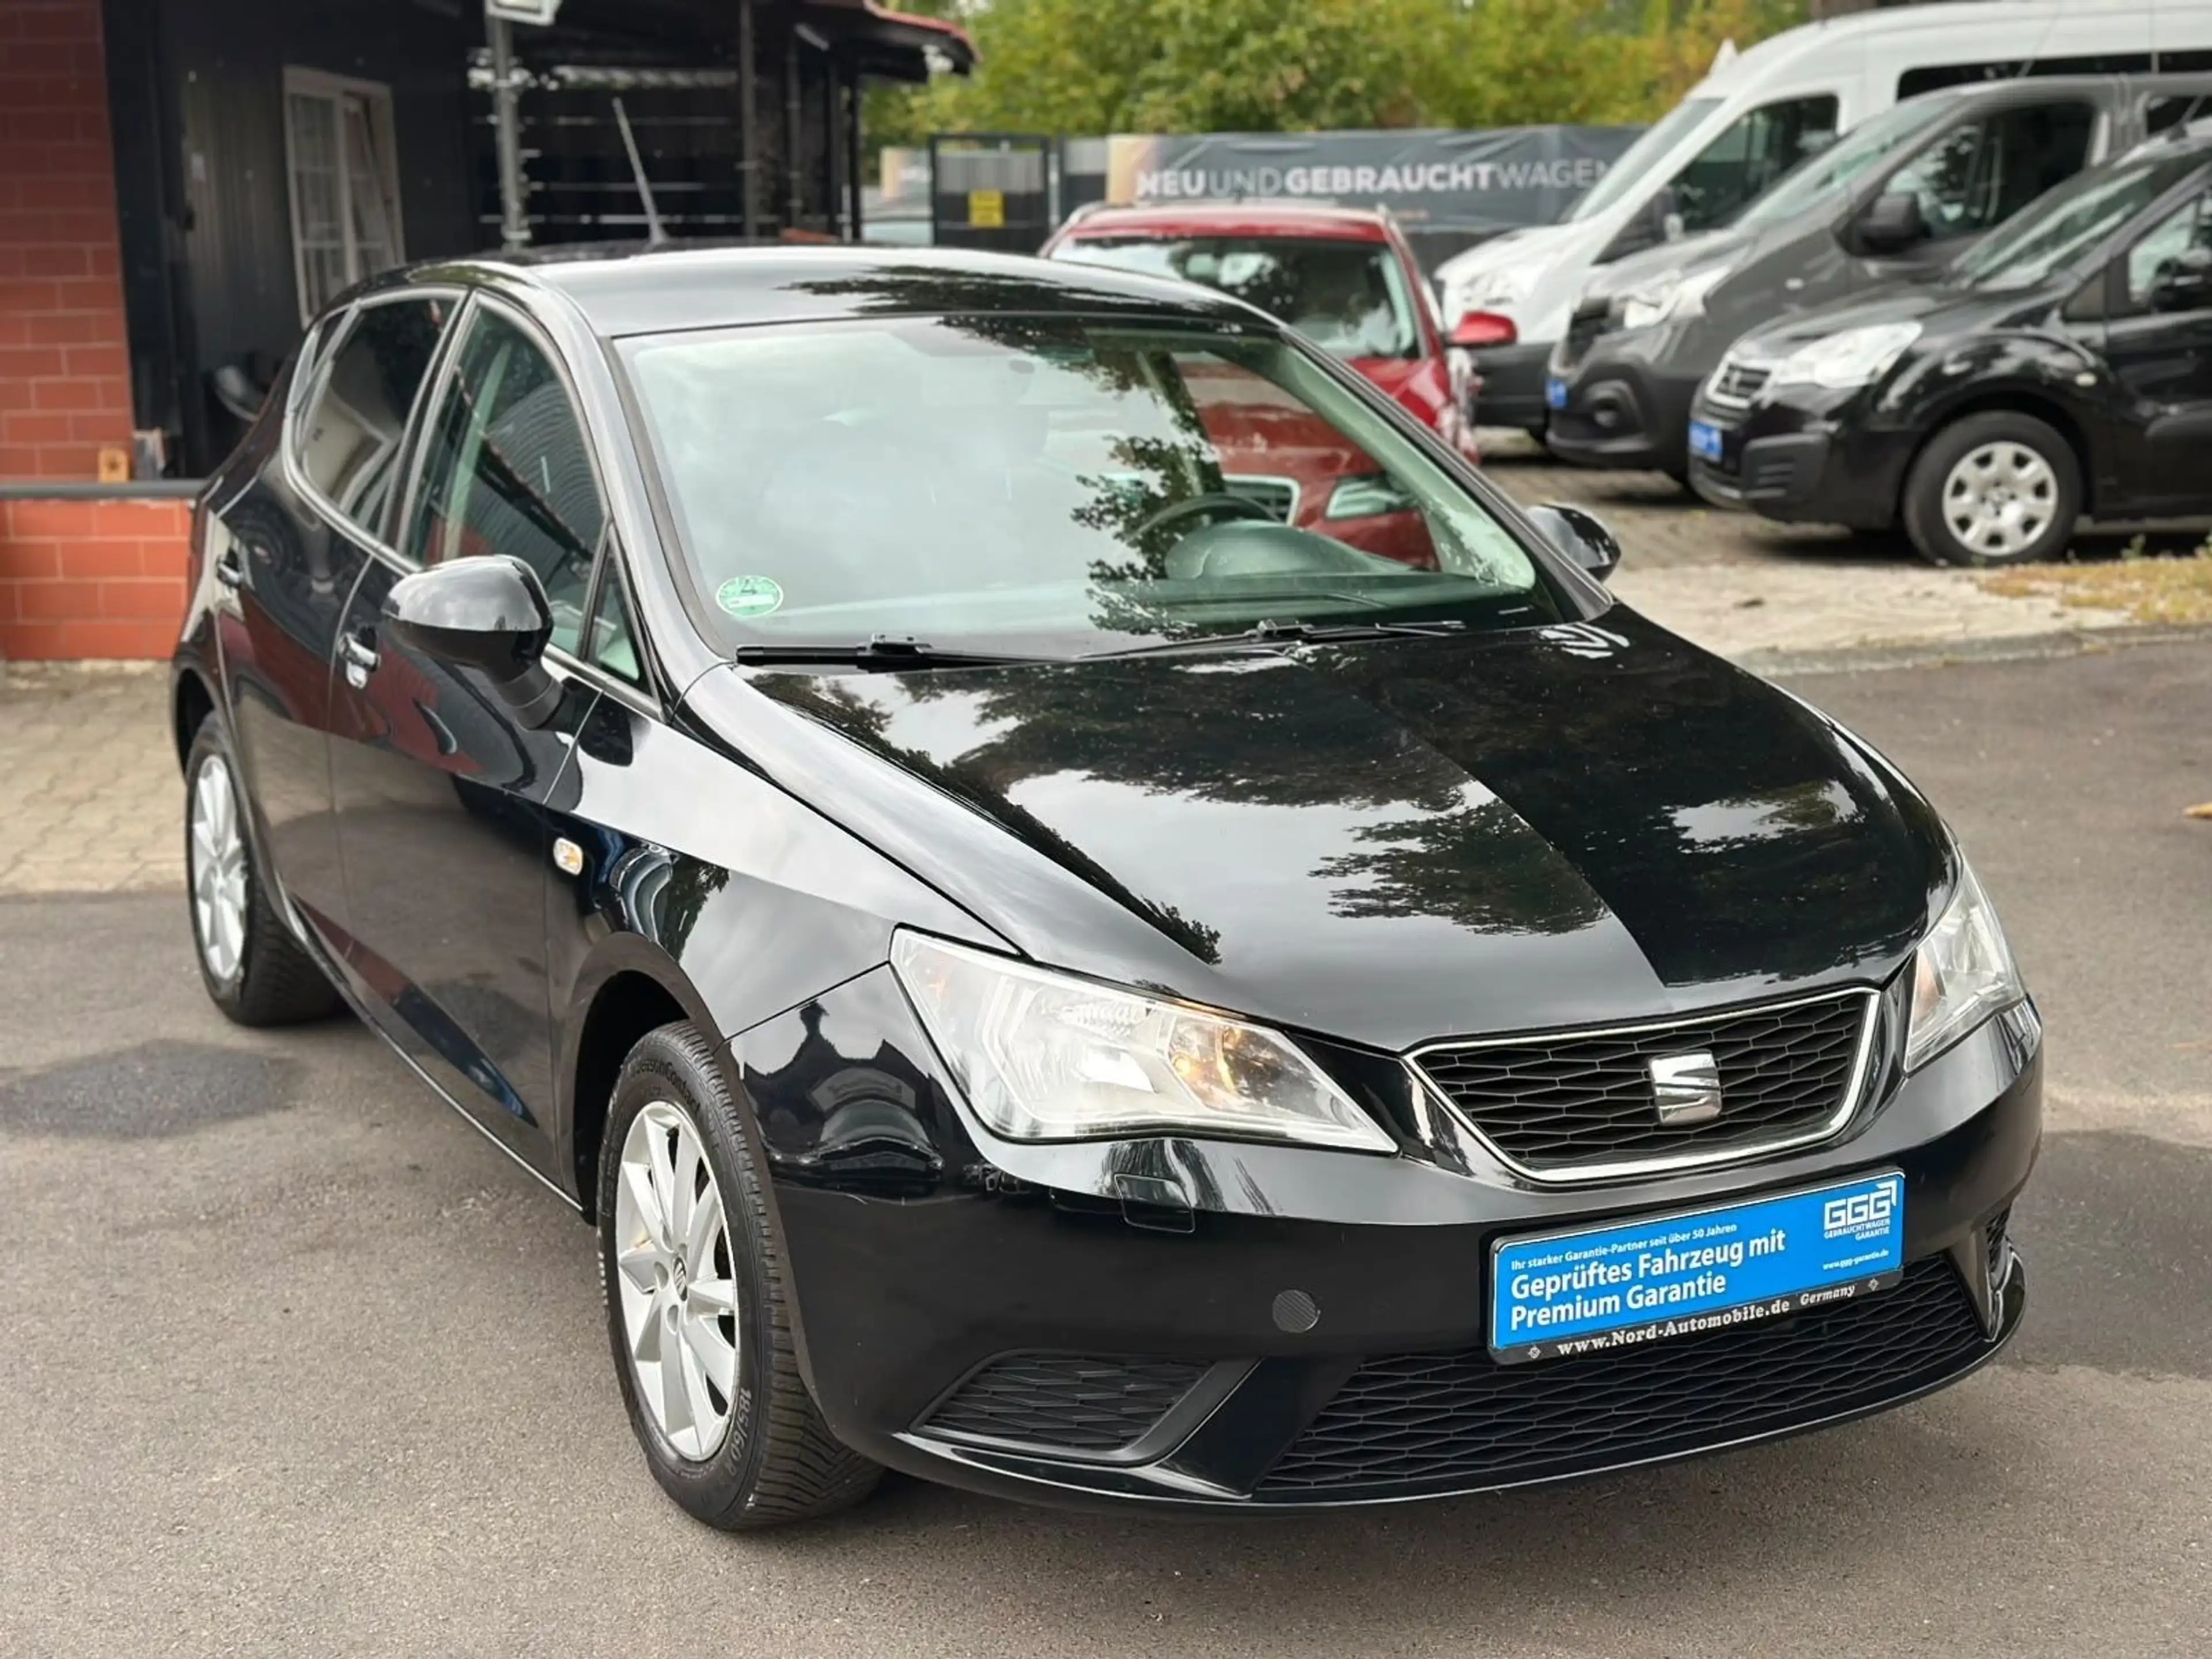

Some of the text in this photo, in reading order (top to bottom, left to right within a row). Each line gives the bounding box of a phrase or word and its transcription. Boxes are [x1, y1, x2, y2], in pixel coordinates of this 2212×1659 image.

[1824, 1188, 1891, 1229] GGG
[1824, 1218, 1891, 1239] GEBRAUCHTWAGEN
[1511, 1223, 1738, 1270] Ihr starker Garantie-Partner seit über 50 Jahren
[1855, 1226, 1890, 1241] GARANTIE
[1511, 1228, 1786, 1302] Geprüftes Fahrzeug mit
[1823, 1248, 1889, 1270] www.ggg-garantie.de
[1511, 1270, 1726, 1331] Premium Garantie
[1557, 1282, 1856, 1356] www.Nord-Automobile.de Germany
